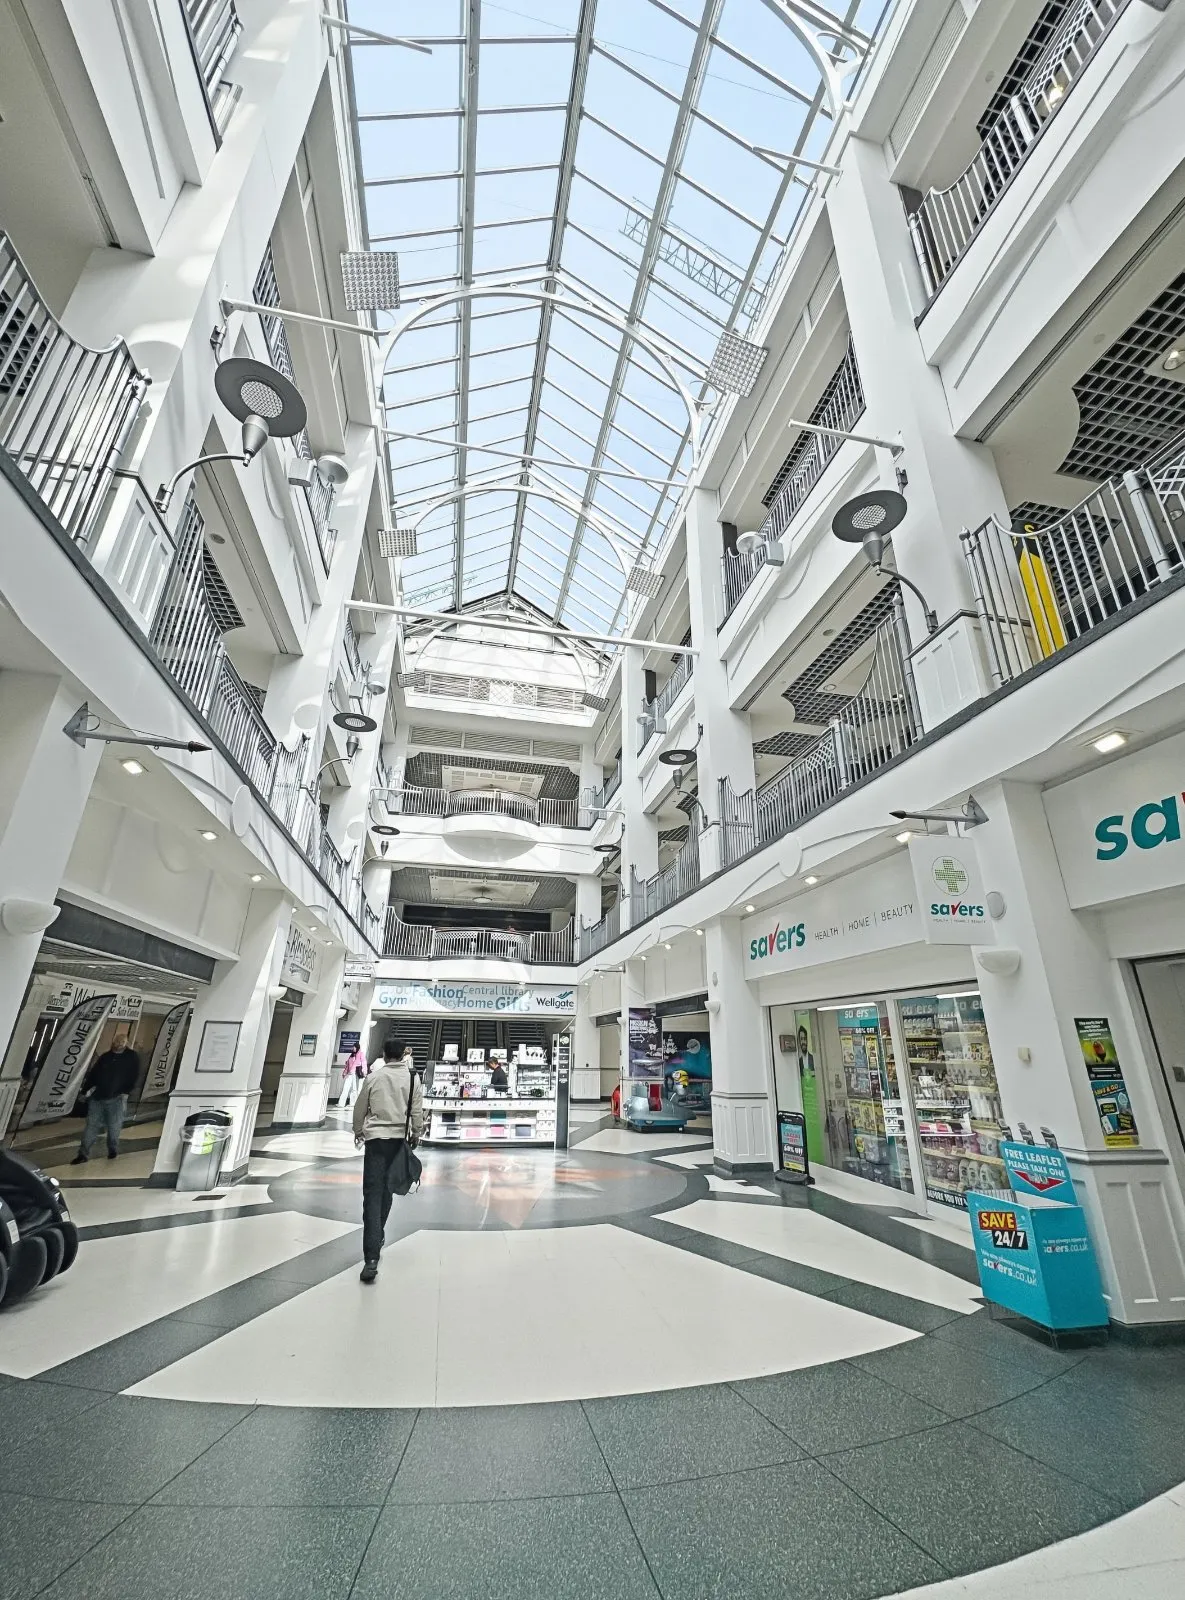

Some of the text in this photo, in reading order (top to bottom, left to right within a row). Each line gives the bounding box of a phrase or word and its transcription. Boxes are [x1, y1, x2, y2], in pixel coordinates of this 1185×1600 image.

[1095, 791, 1185, 861] sa
[931, 901, 984, 917] savers
[814, 903, 914, 941] HEALTH HOME BEAUTY
[750, 922, 806, 960] savers
[412, 984, 464, 999] Fashion
[462, 984, 498, 996] Central
[501, 985, 534, 998] library
[379, 992, 408, 1008] Gym
[457, 997, 494, 1009] Home
[495, 997, 530, 1011] Gifts
[536, 997, 575, 1009] Wellgate
[844, 1009, 869, 1019] saers
[49, 1022, 92, 1096] WELCOME
[155, 1024, 178, 1080] WELCOME
[1004, 1147, 1062, 1168] FREE LEAFLET
[1007, 1159, 1030, 1171] PLEASE
[1030, 1164, 1048, 1174] TAKE
[1048, 1168, 1067, 1178] ONE
[981, 1212, 1015, 1229] SAVE
[994, 1230, 1025, 1248] 24/7
[982, 1257, 1038, 1287] savers.co.uk
